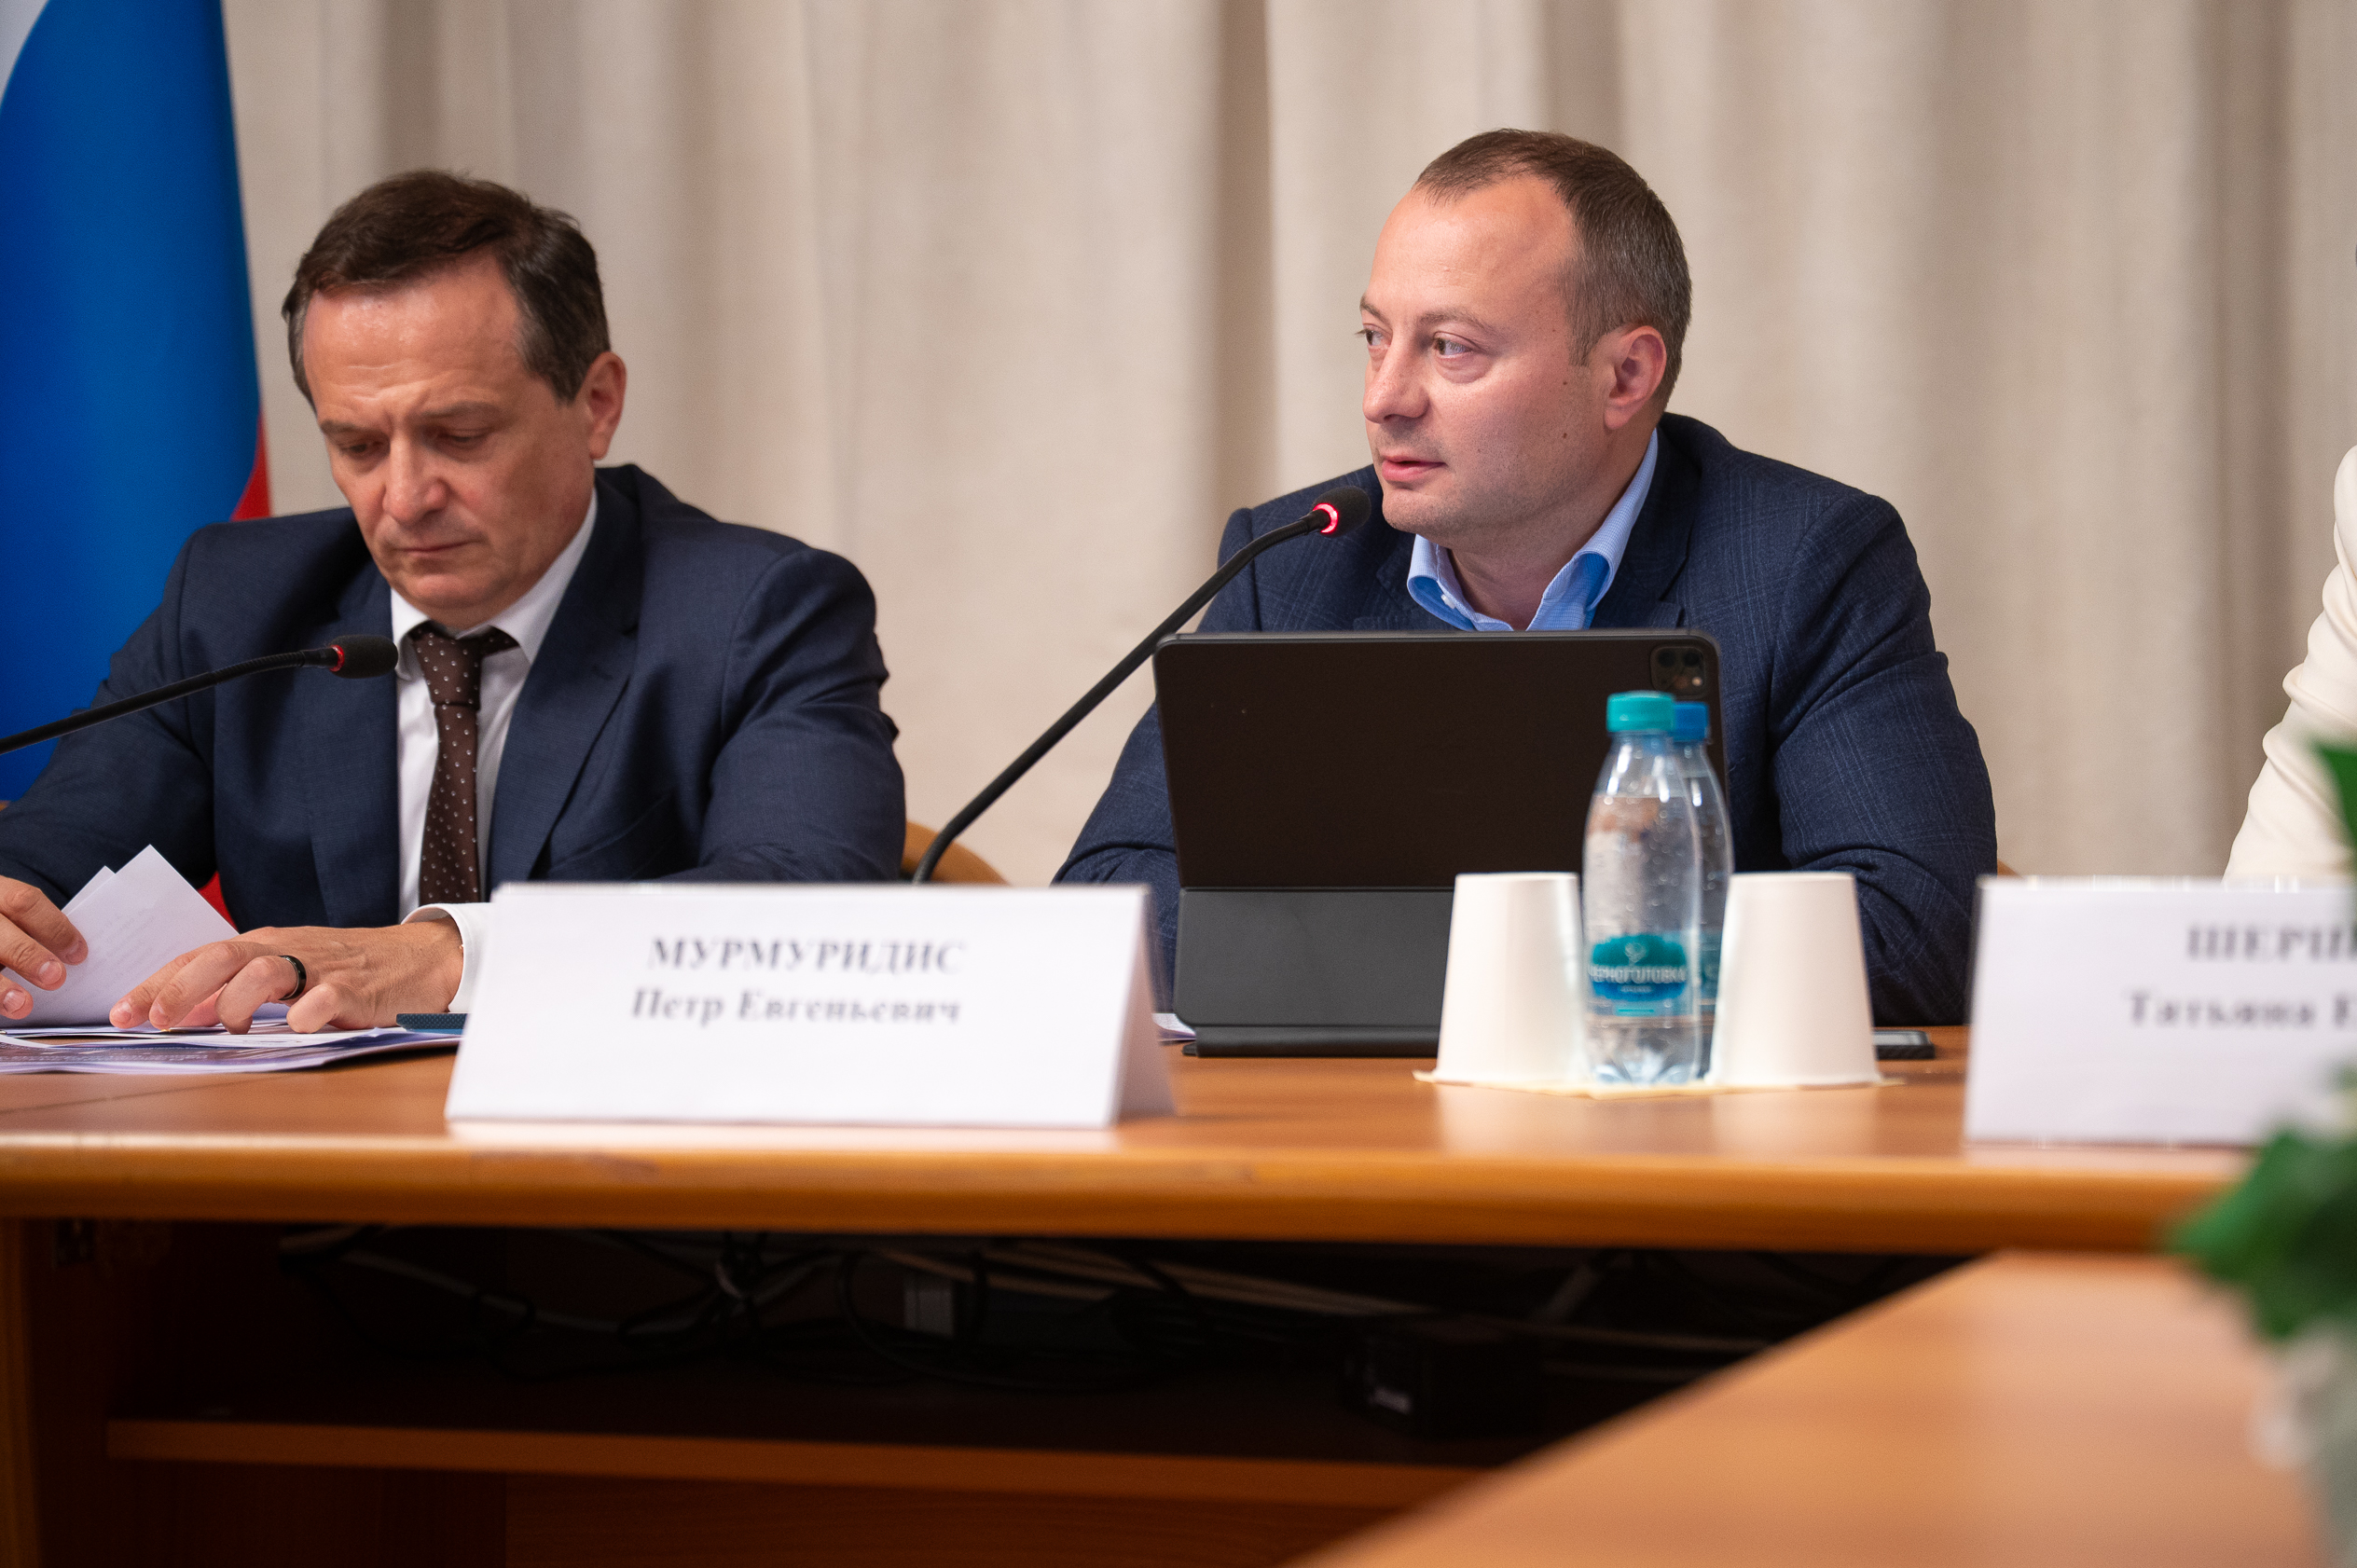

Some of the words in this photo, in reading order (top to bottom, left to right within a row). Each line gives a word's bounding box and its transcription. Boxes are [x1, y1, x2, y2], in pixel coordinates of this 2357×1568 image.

[648, 937, 966, 973] МУРМУРИДИС
[631, 988, 724, 1026] Петр
[738, 989, 961, 1024] Евгеньевич
